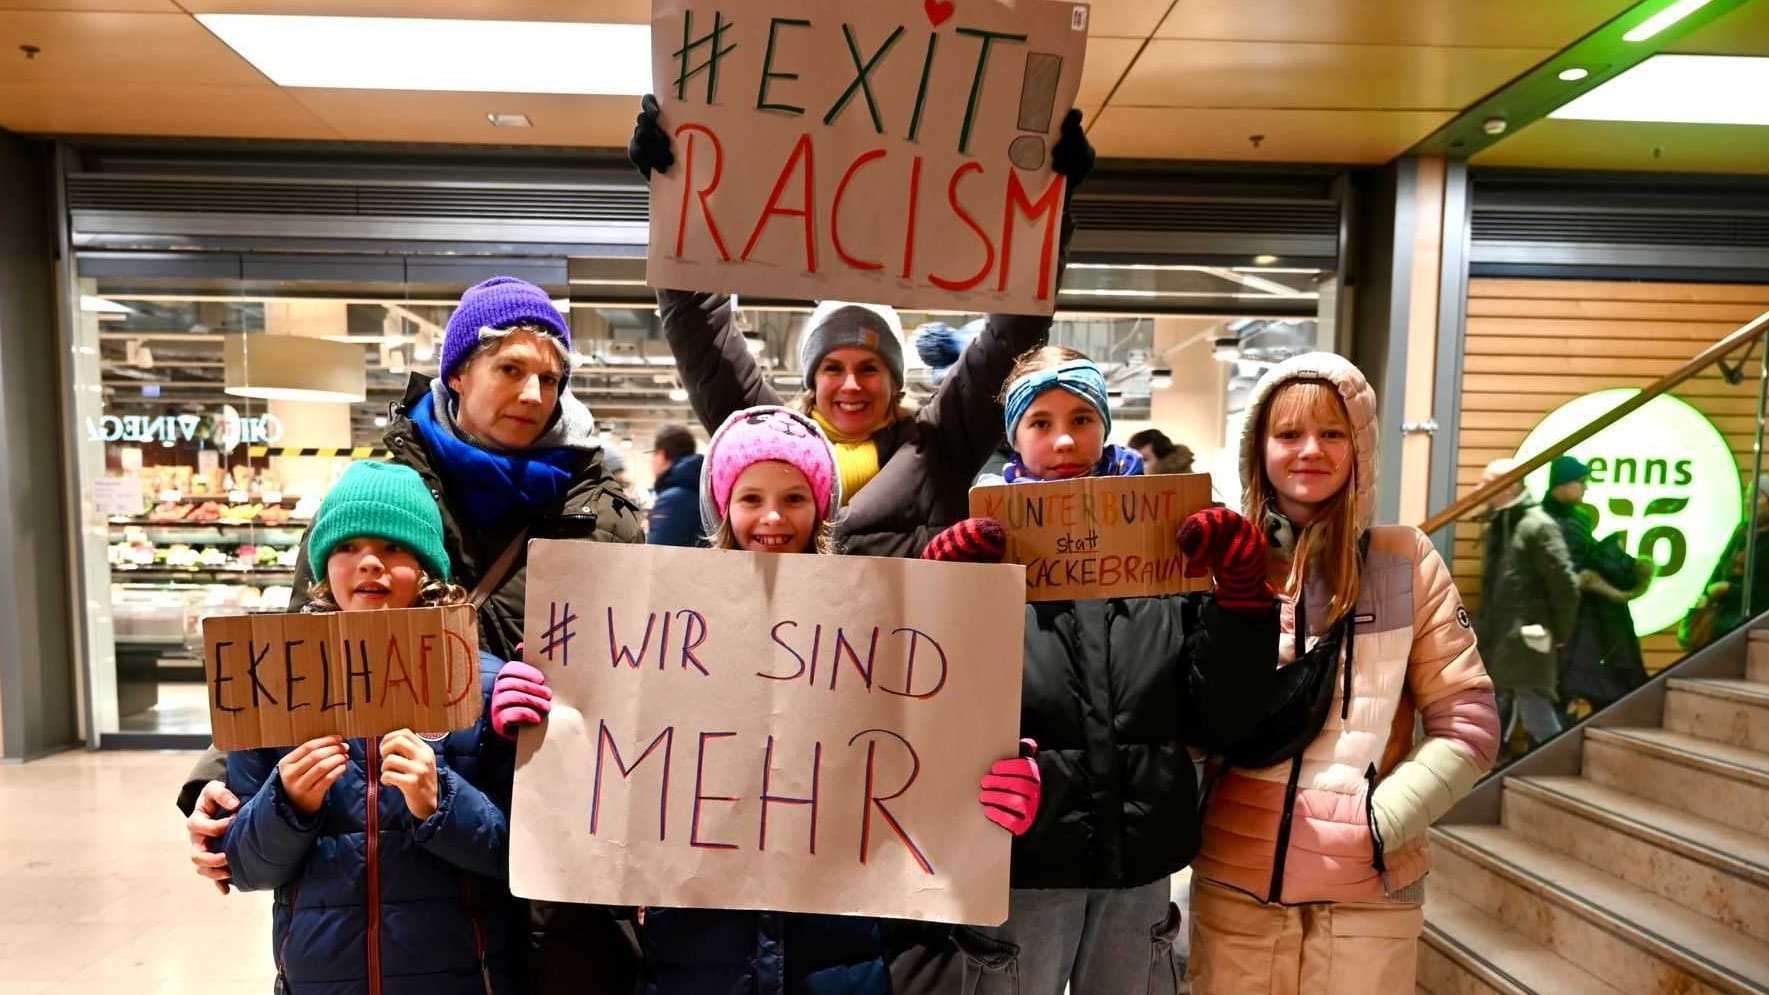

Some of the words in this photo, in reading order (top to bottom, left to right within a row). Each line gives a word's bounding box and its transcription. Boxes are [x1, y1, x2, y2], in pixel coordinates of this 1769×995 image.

[675, 123, 1067, 300] RACISM
[1586, 457, 1692, 485] enns
[1056, 530, 1098, 554] statt
[756, 620, 949, 701] SIND
[590, 718, 935, 876] MEHR
